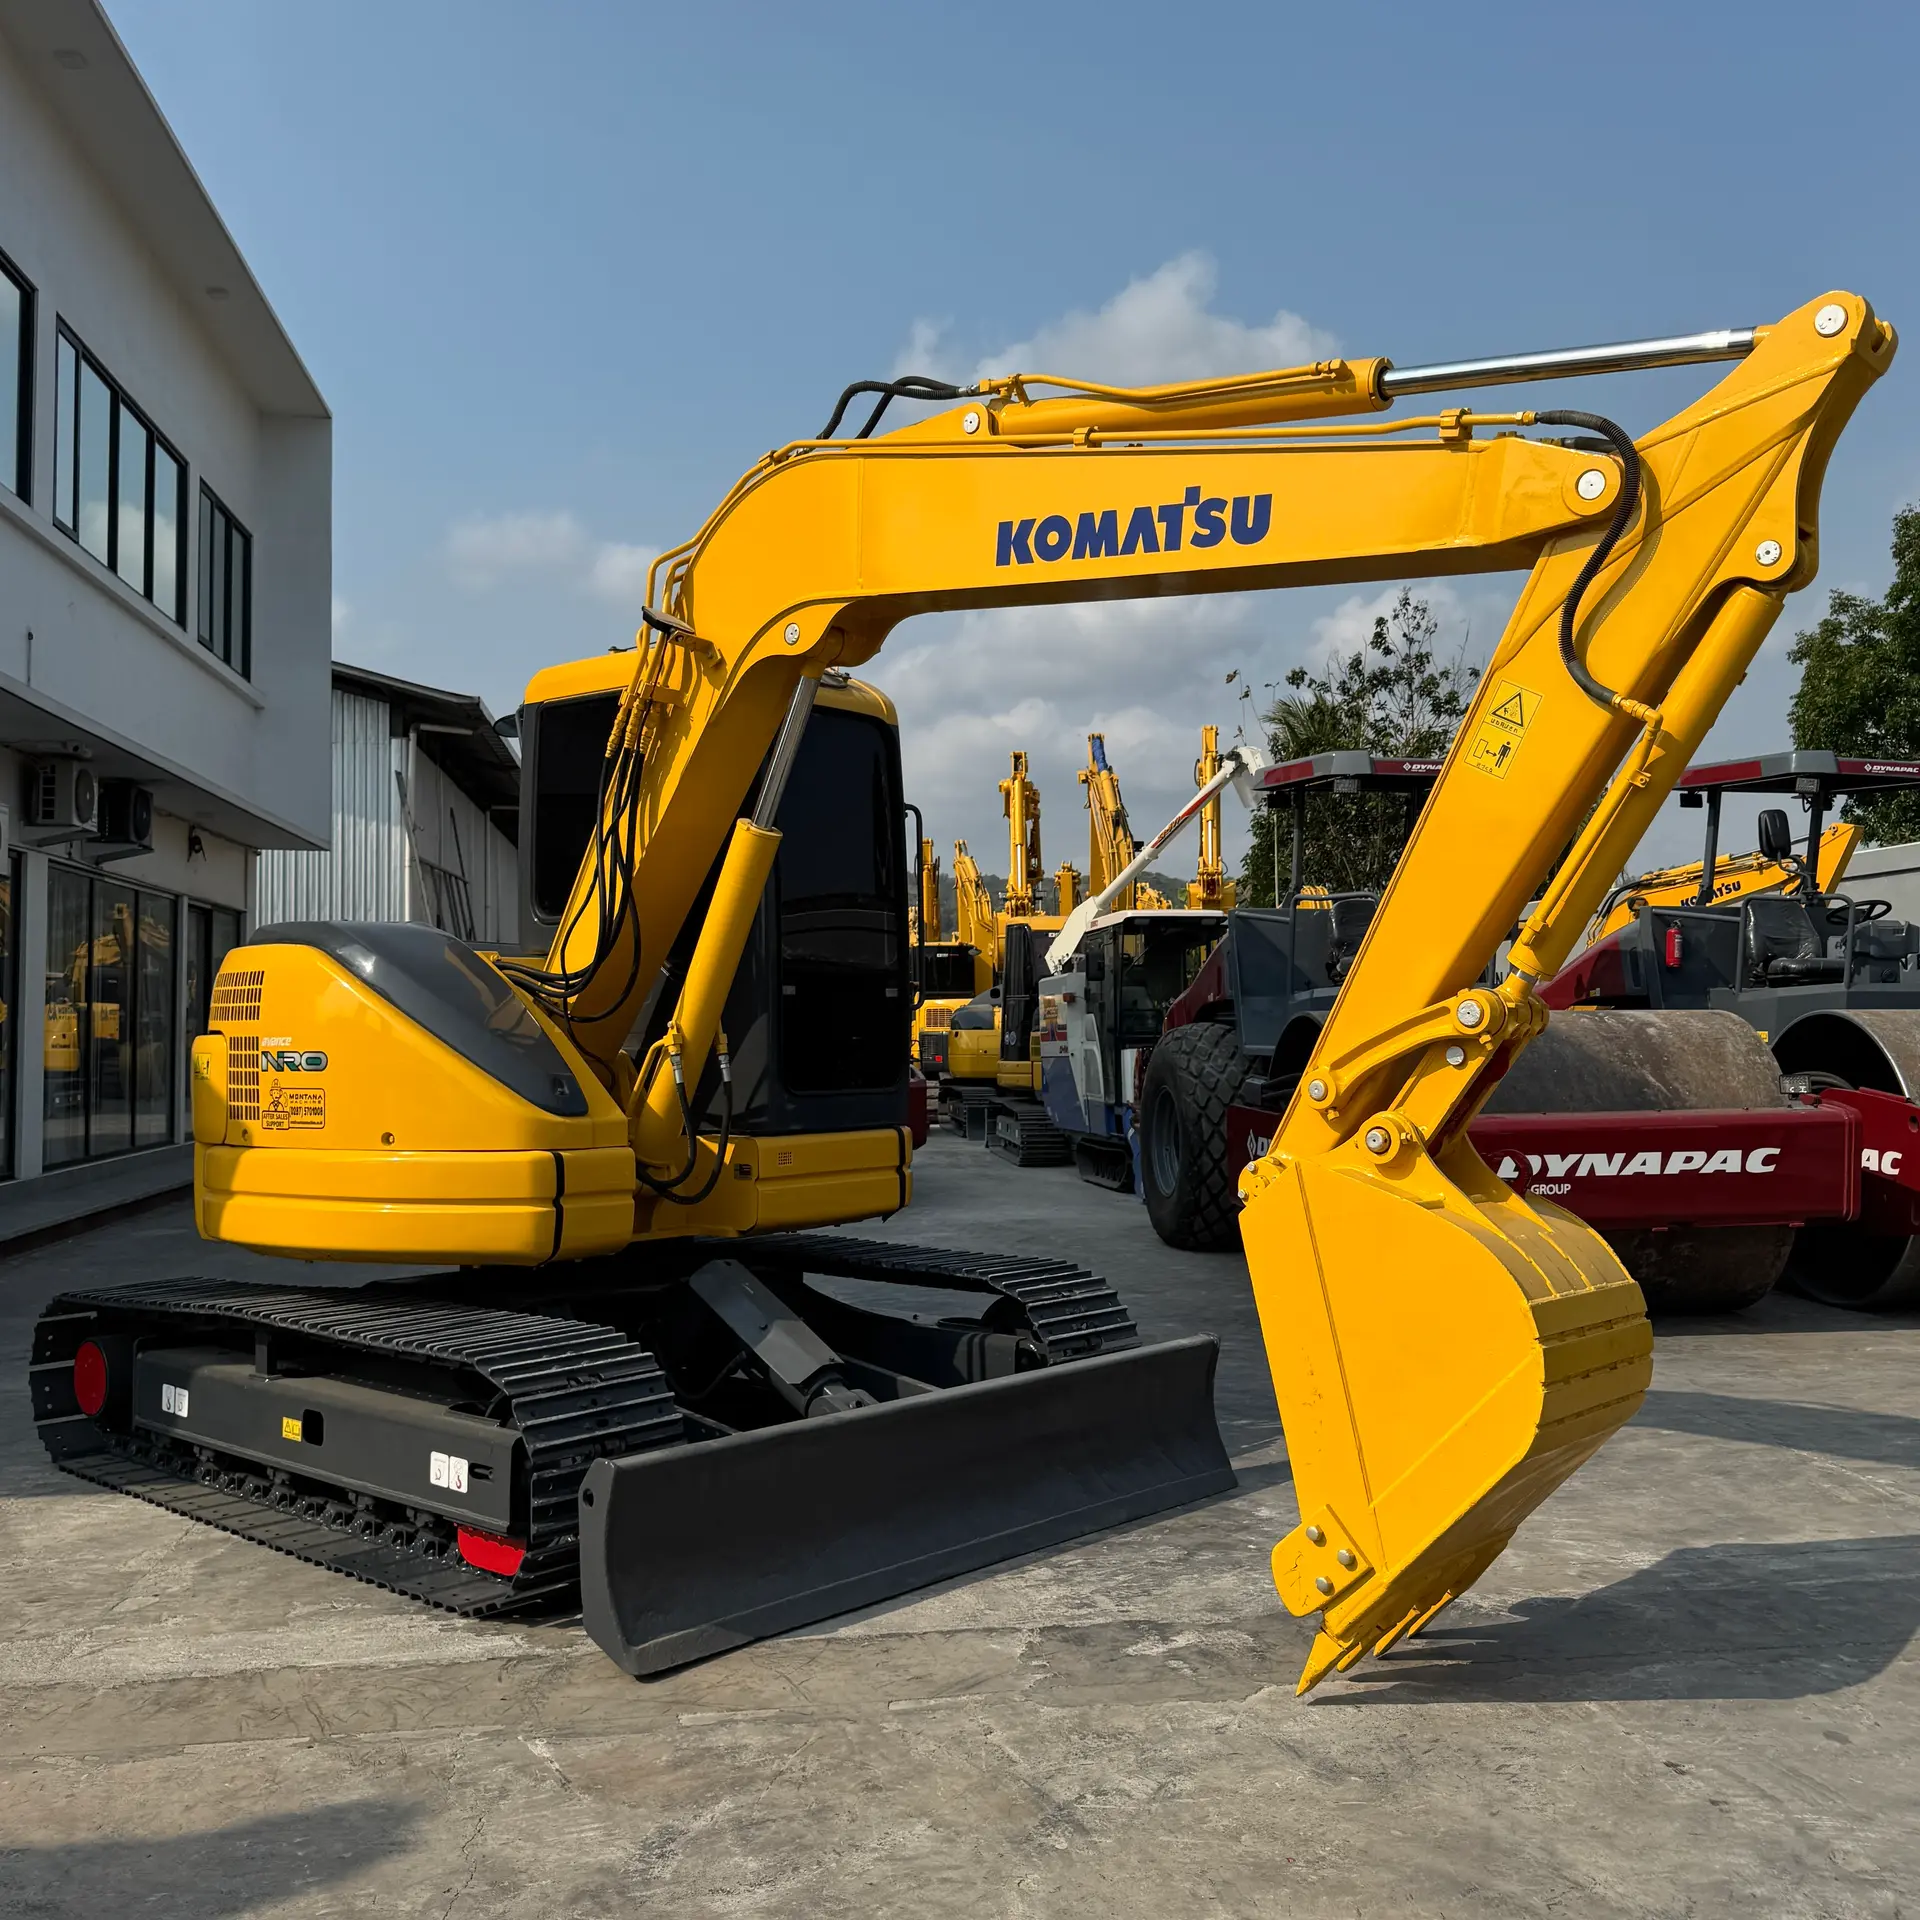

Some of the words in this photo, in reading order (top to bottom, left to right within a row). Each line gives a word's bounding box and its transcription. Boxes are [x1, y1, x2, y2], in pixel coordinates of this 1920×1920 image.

[995, 486, 1273, 567] KOMATSU
[1872, 765, 1919, 773] DYNAPAC
[1530, 1183, 1572, 1195] GROUP
